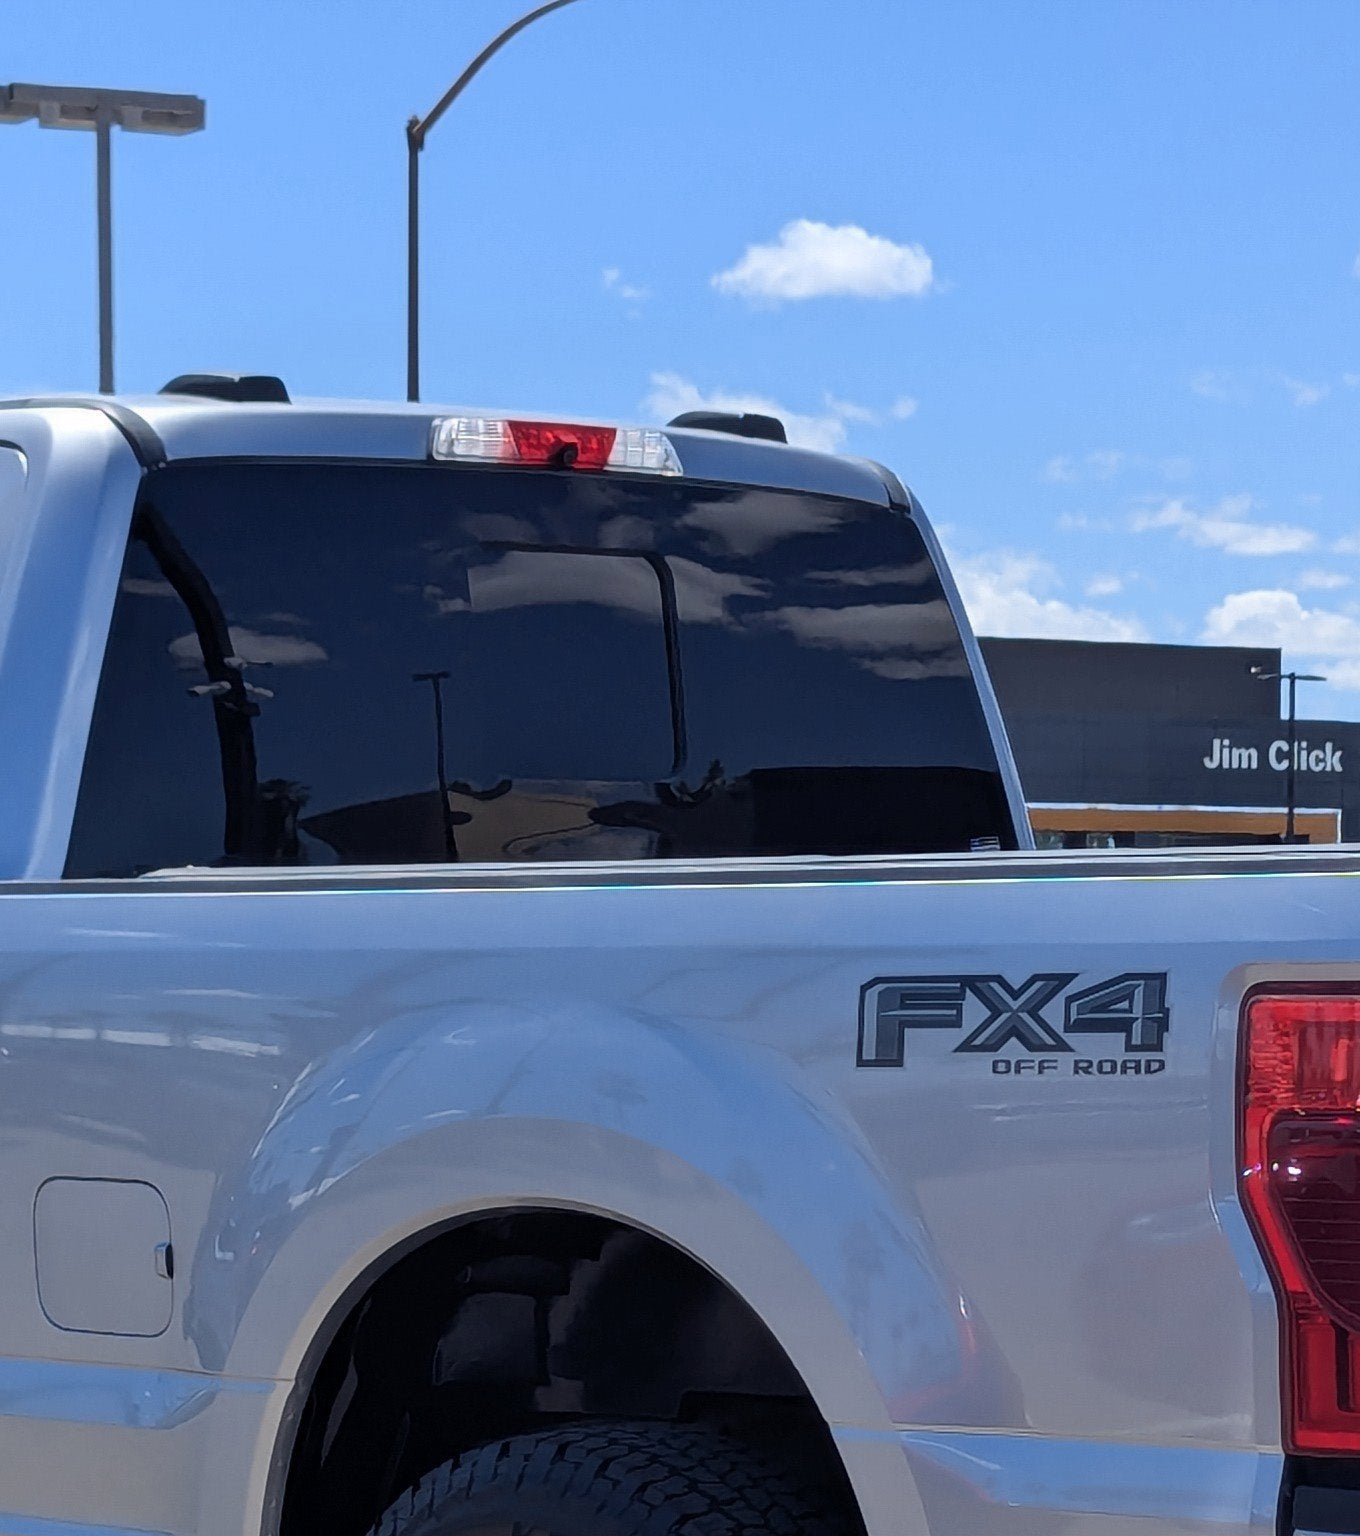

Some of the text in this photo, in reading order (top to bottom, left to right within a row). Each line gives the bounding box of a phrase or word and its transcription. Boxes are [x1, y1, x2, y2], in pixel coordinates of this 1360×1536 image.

[1202, 737, 1344, 773] Jim Click
[855, 972, 1170, 1068] FX4
[991, 1058, 1166, 1076] OFF ROAD
